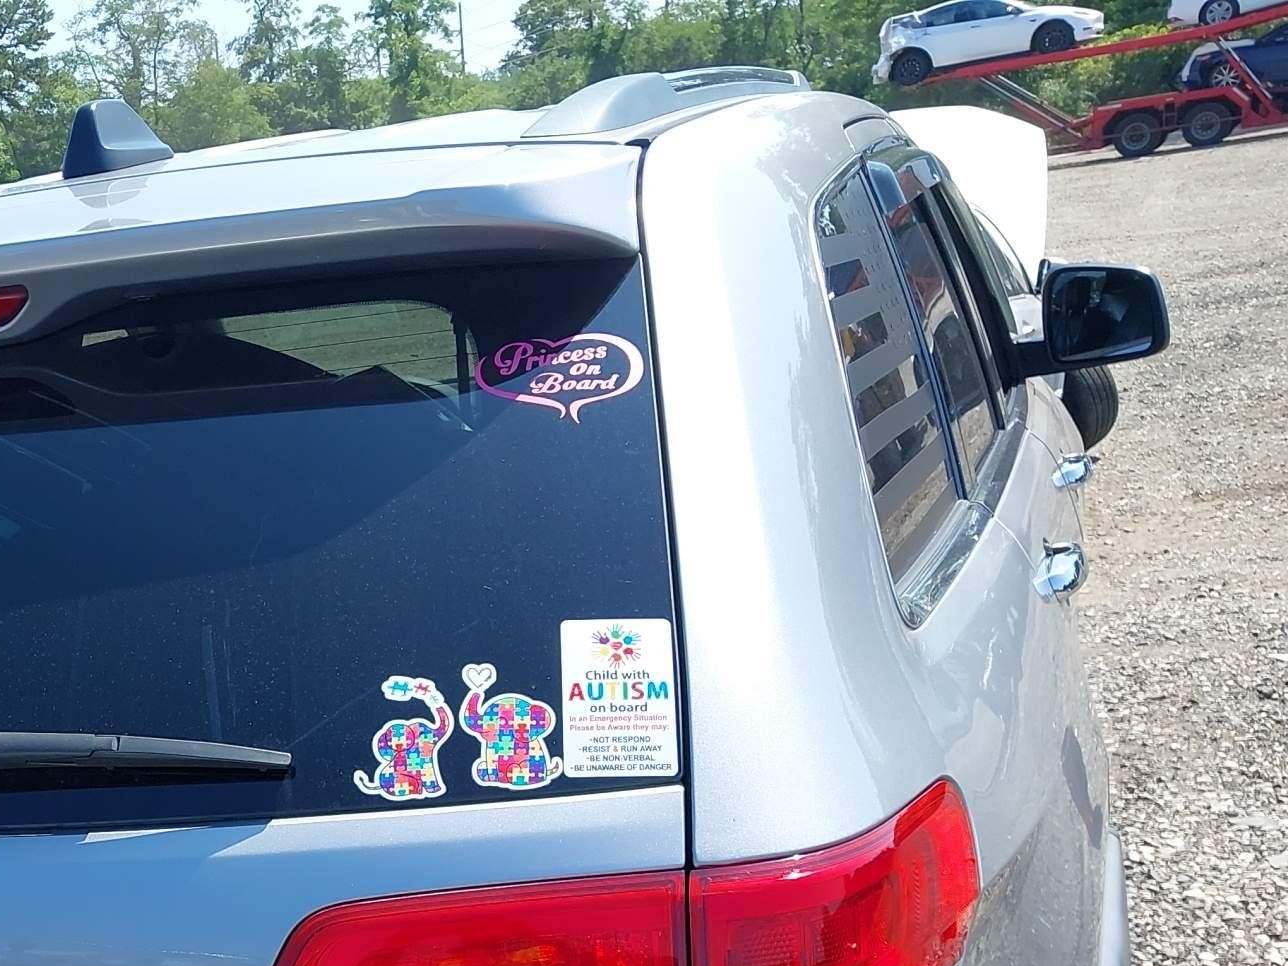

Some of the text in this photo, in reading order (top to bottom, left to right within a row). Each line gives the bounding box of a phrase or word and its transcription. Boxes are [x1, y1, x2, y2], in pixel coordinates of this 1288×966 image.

[494, 341, 608, 376] Princess
[569, 362, 601, 376] On
[529, 372, 620, 395] Board
[585, 669, 650, 681] Child with
[569, 681, 669, 701] AUTISM
[590, 702, 648, 713] on board
[589, 715, 632, 724] Emergency
[634, 714, 668, 722] Situation
[632, 724, 650, 732] they
[639, 763, 672, 771] DANGER
